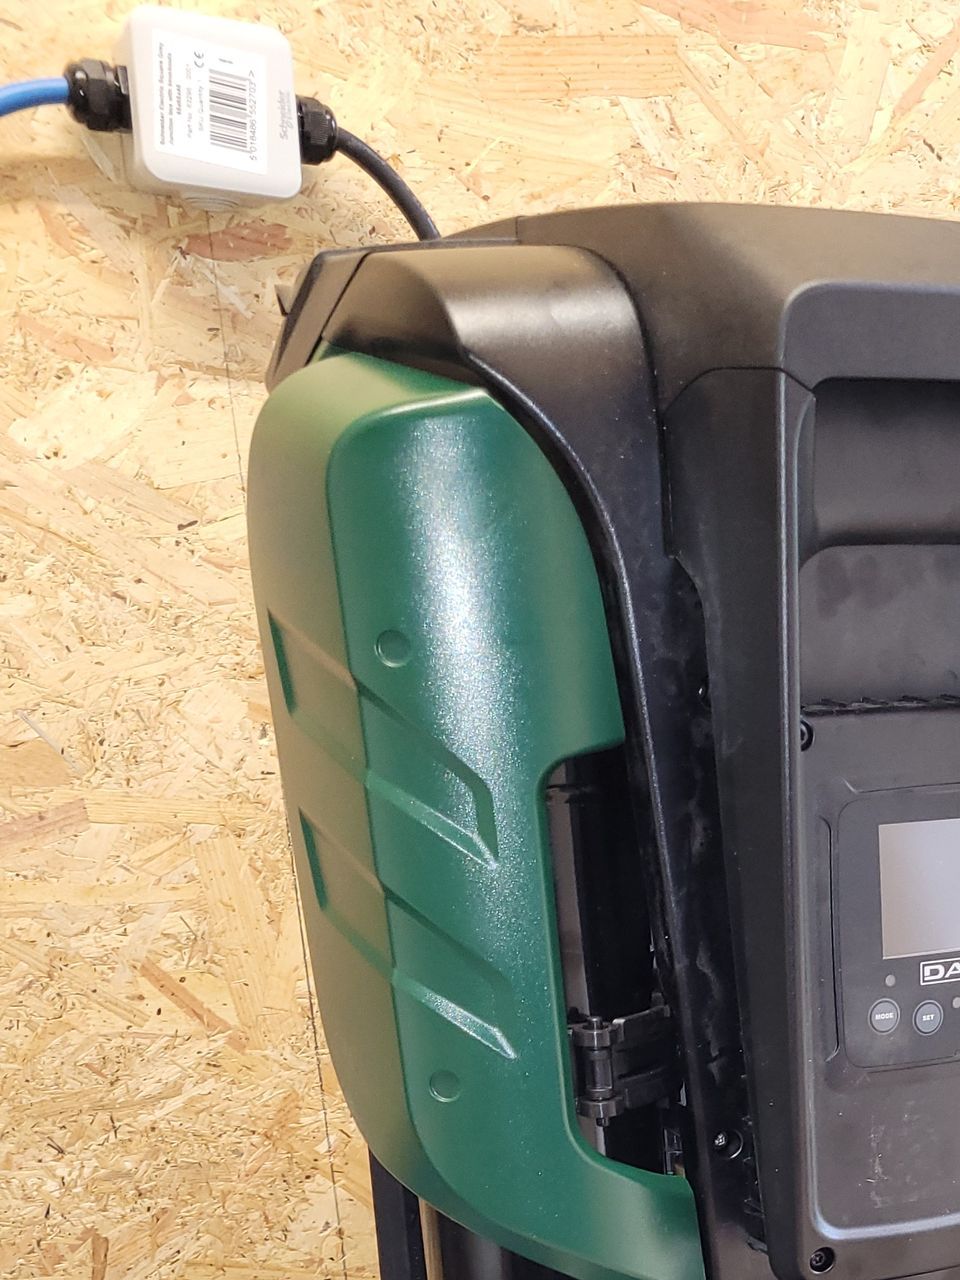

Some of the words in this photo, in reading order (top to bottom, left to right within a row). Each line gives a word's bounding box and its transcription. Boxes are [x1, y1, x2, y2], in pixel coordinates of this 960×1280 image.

[248, 82, 256, 115] 552703
[279, 90, 288, 139] Schneider
[249, 119, 257, 151] 018486
[875, 1012, 894, 1020] MODE
[922, 1013, 935, 1021] SET
